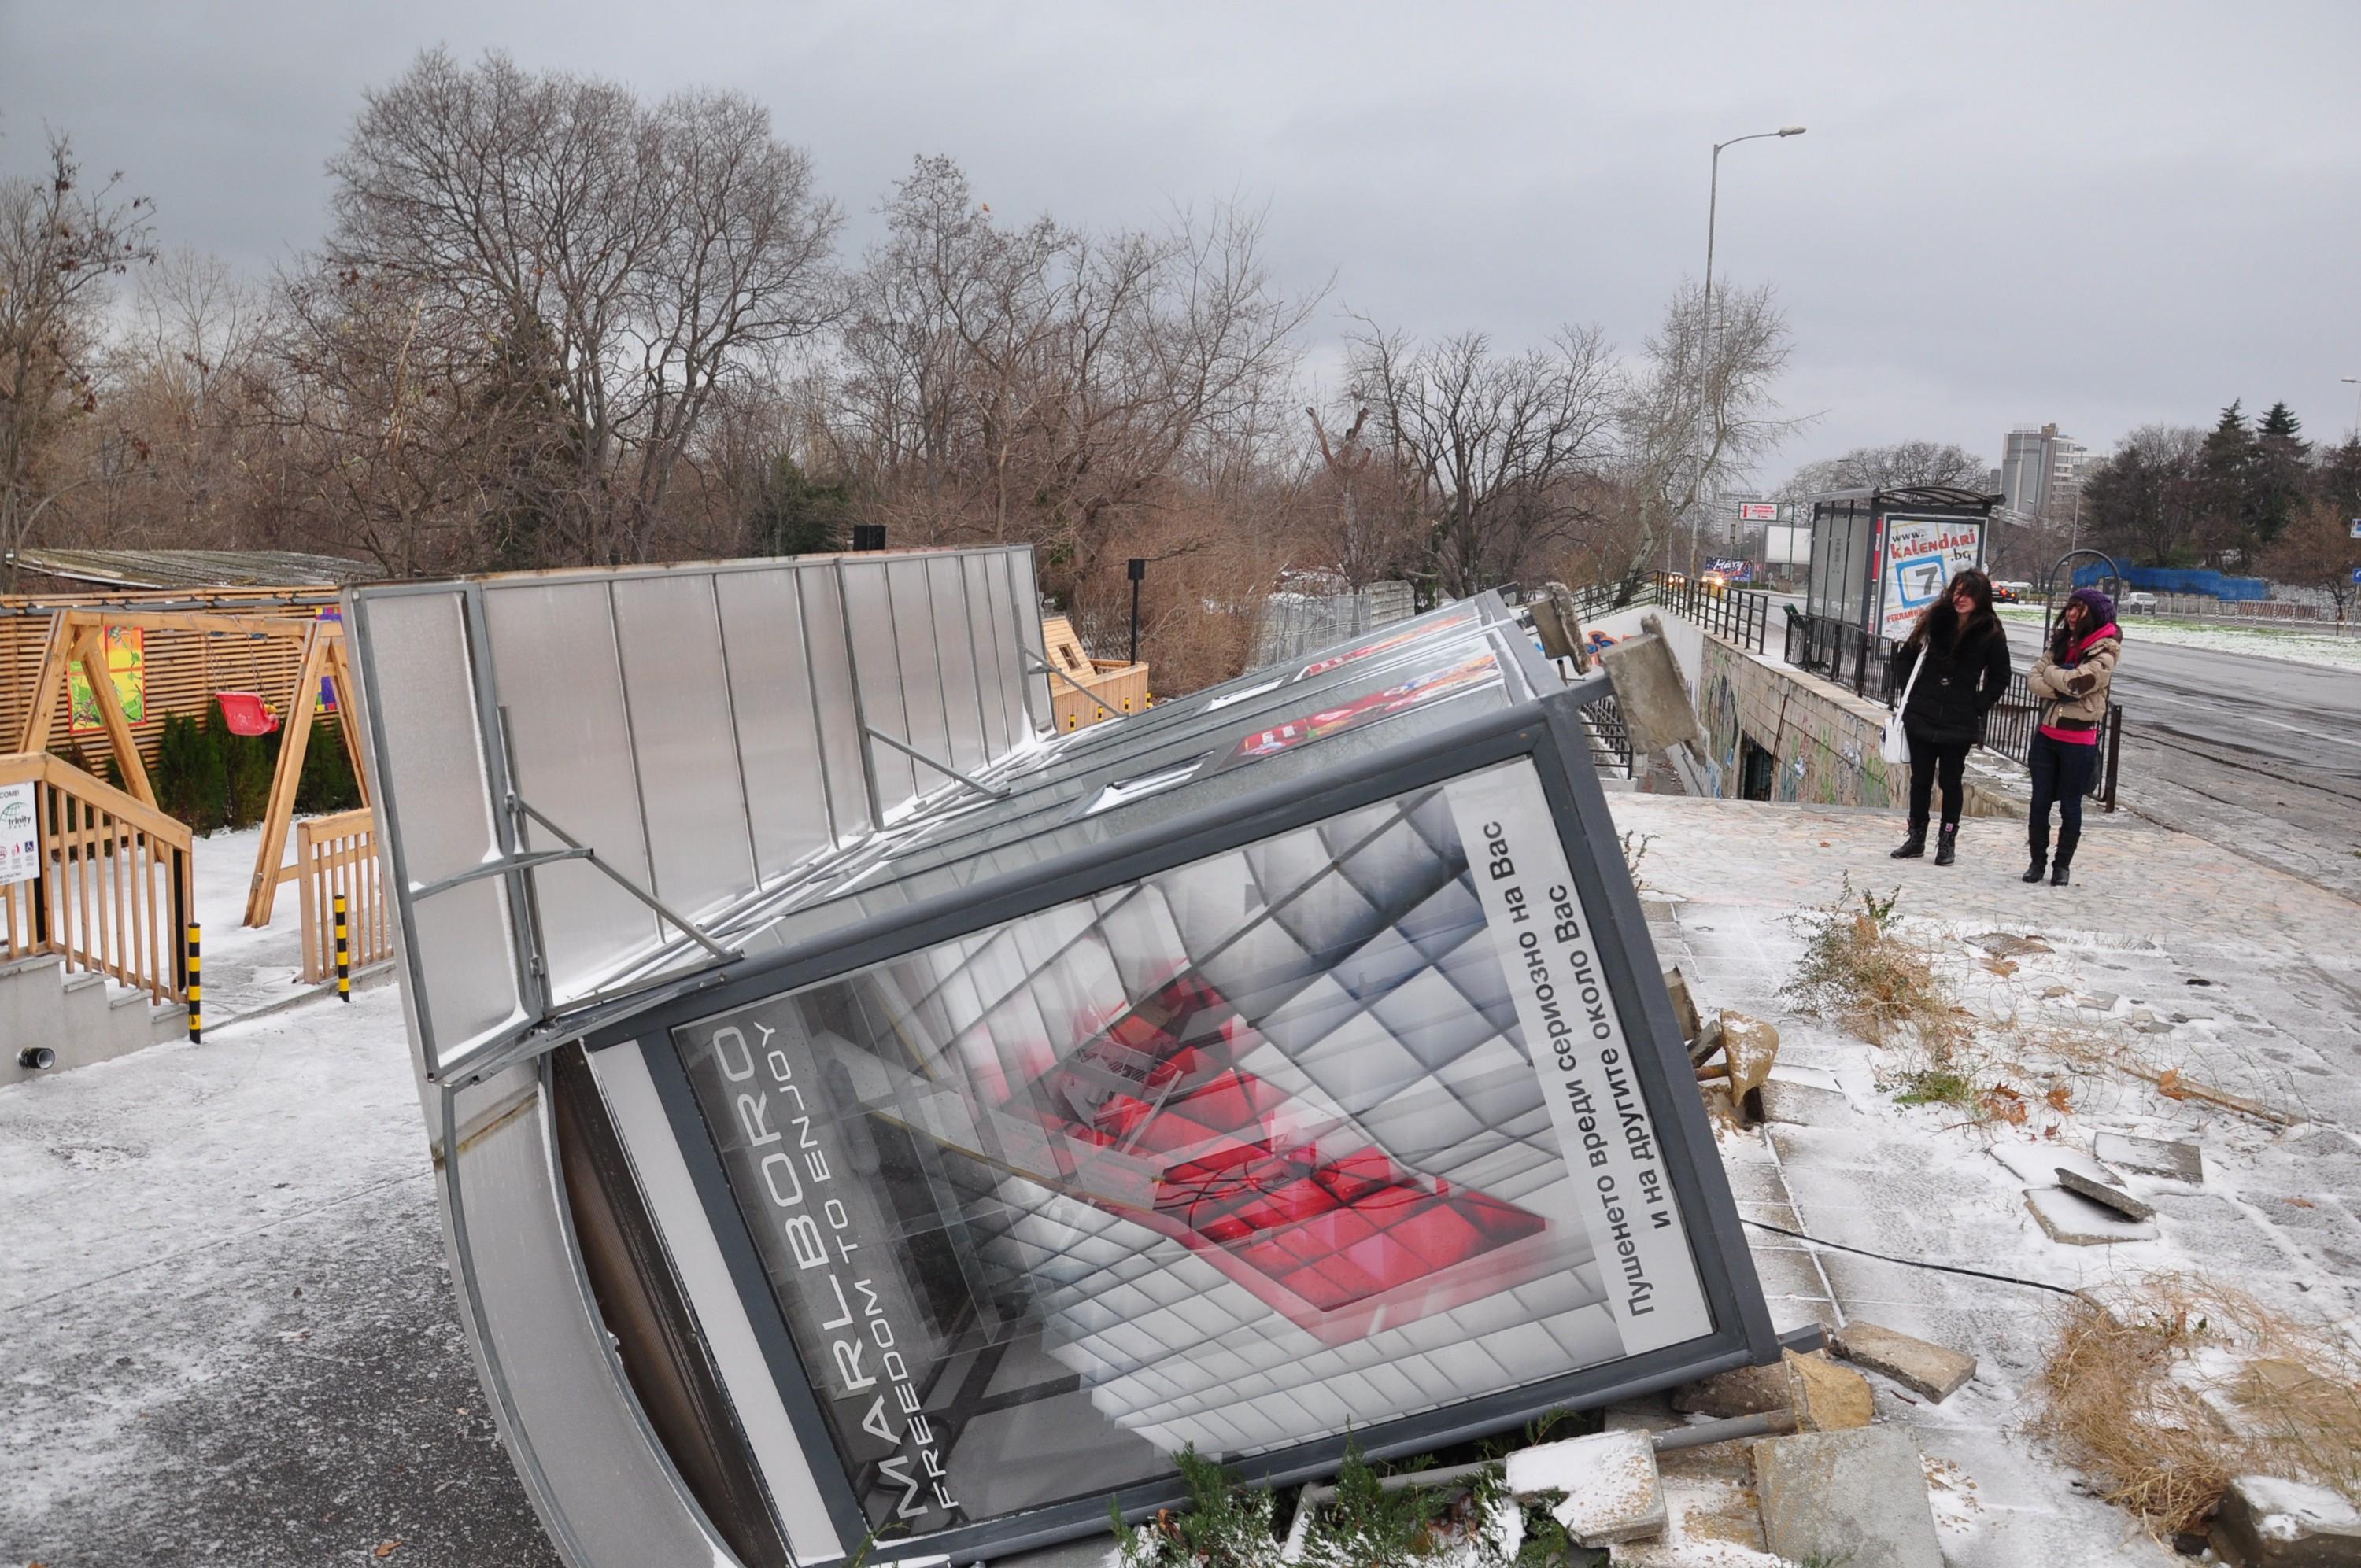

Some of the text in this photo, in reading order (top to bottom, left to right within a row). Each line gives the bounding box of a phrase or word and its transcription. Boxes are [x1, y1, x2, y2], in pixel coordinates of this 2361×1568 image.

[1915, 566, 1938, 596] 7
[8, 815, 31, 825] trinity
[1483, 821, 1654, 1316] Пушенето вреди сериозно на Вас
[1549, 884, 1671, 1228] и на другите около Вас
[712, 1026, 929, 1518] MARLBORO
[754, 1020, 959, 1509] FREEDOM TO ENJOY
